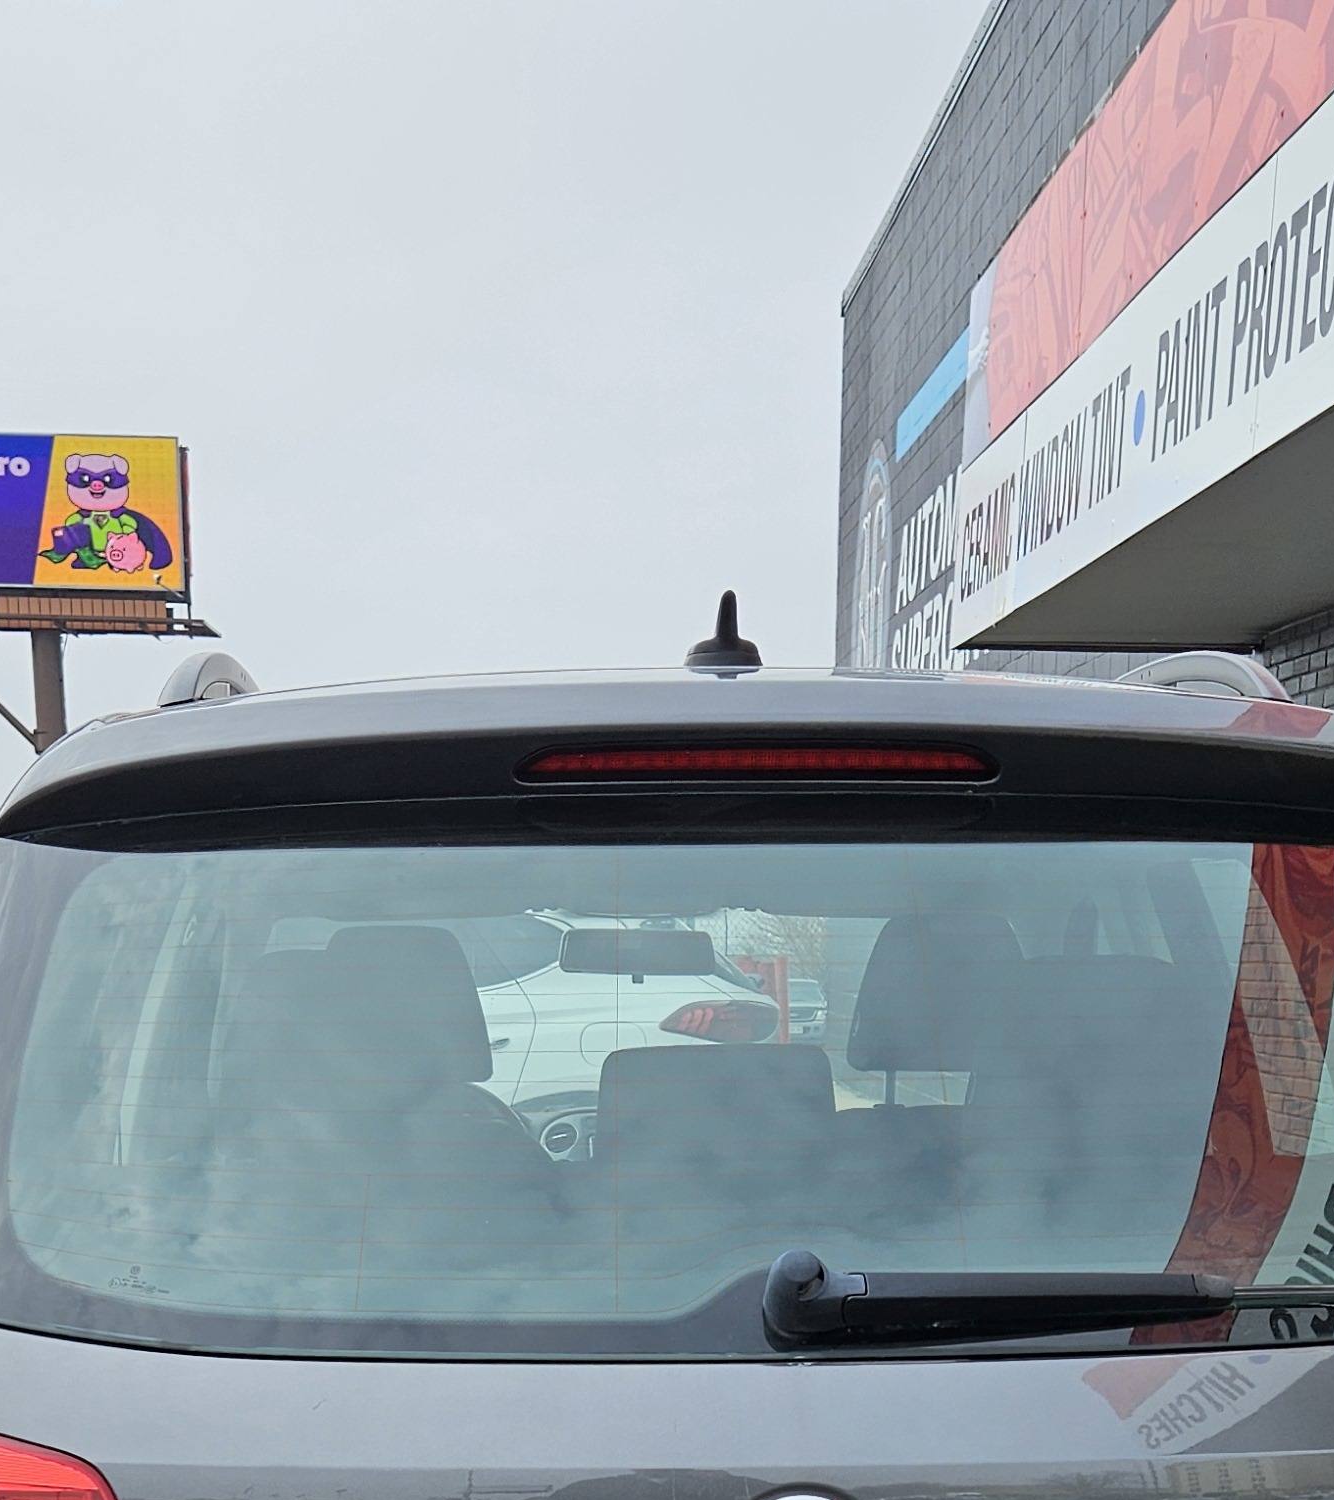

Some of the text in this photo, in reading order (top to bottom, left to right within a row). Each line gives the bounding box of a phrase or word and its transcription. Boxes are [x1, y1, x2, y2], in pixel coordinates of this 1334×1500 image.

[961, 472, 1015, 602] CERAMIC
[1016, 406, 1088, 562] WINDOW
[1089, 365, 1132, 510] TINT
[1151, 276, 1227, 463] PAINT
